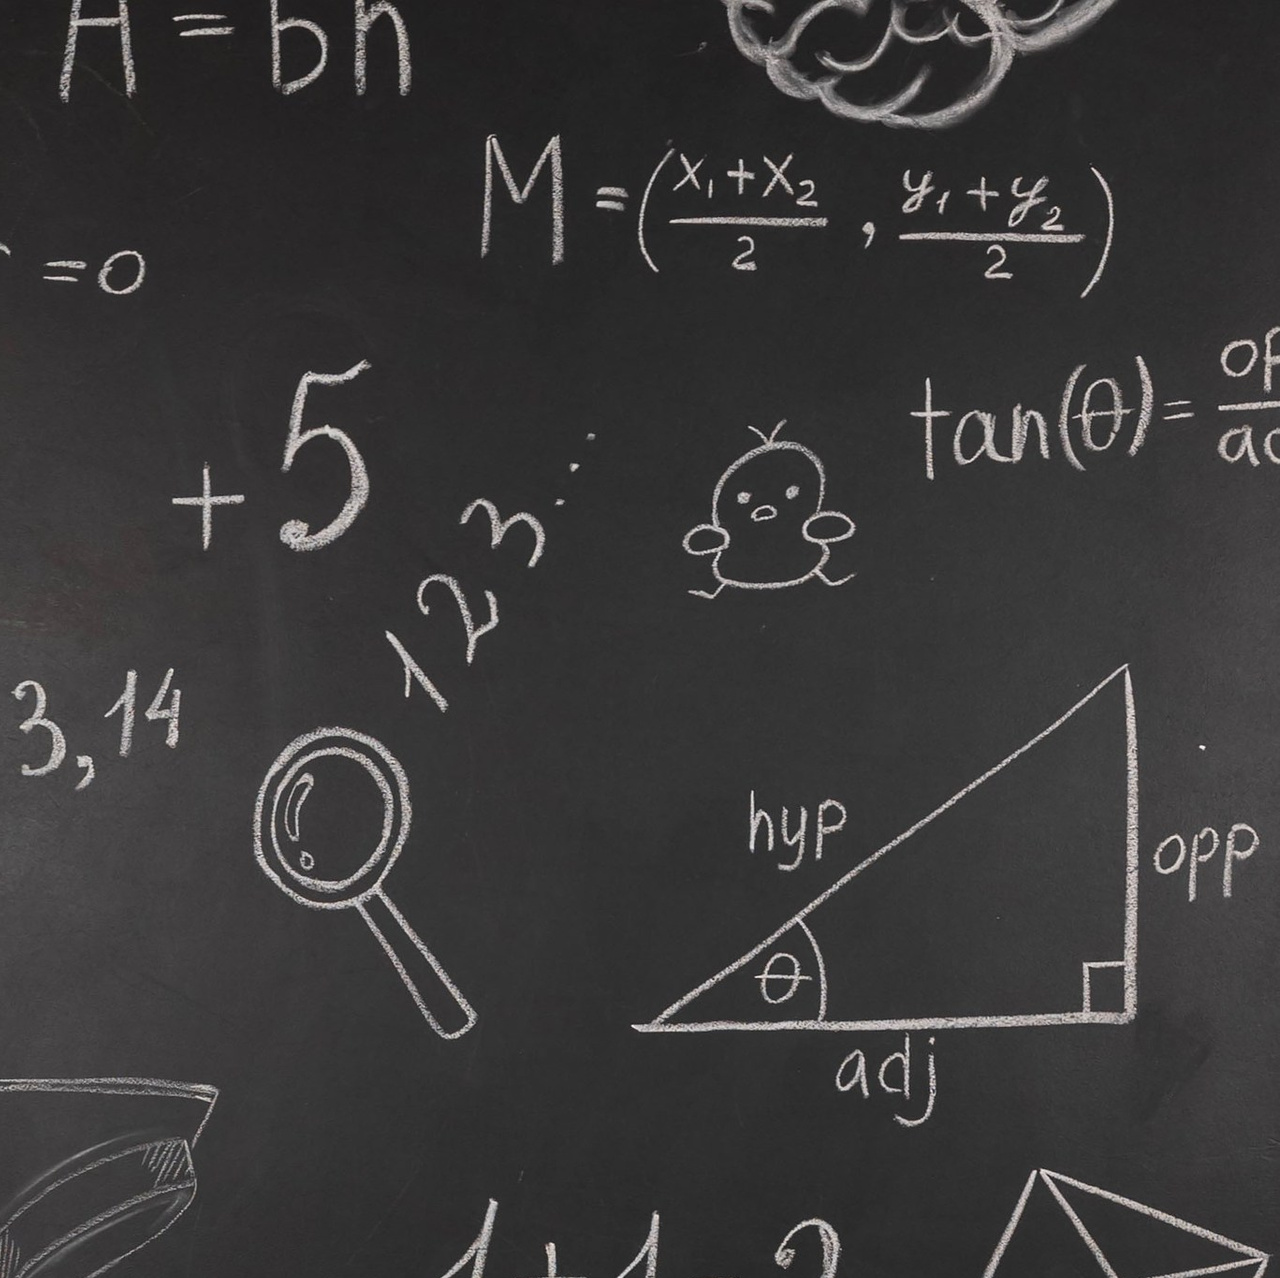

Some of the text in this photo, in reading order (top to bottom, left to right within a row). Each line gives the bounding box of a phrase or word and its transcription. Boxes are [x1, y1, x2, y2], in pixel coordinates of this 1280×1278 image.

[749, 790, 847, 871] hyp
[1153, 823, 1259, 902] opp
[836, 1034, 936, 1127] adj
